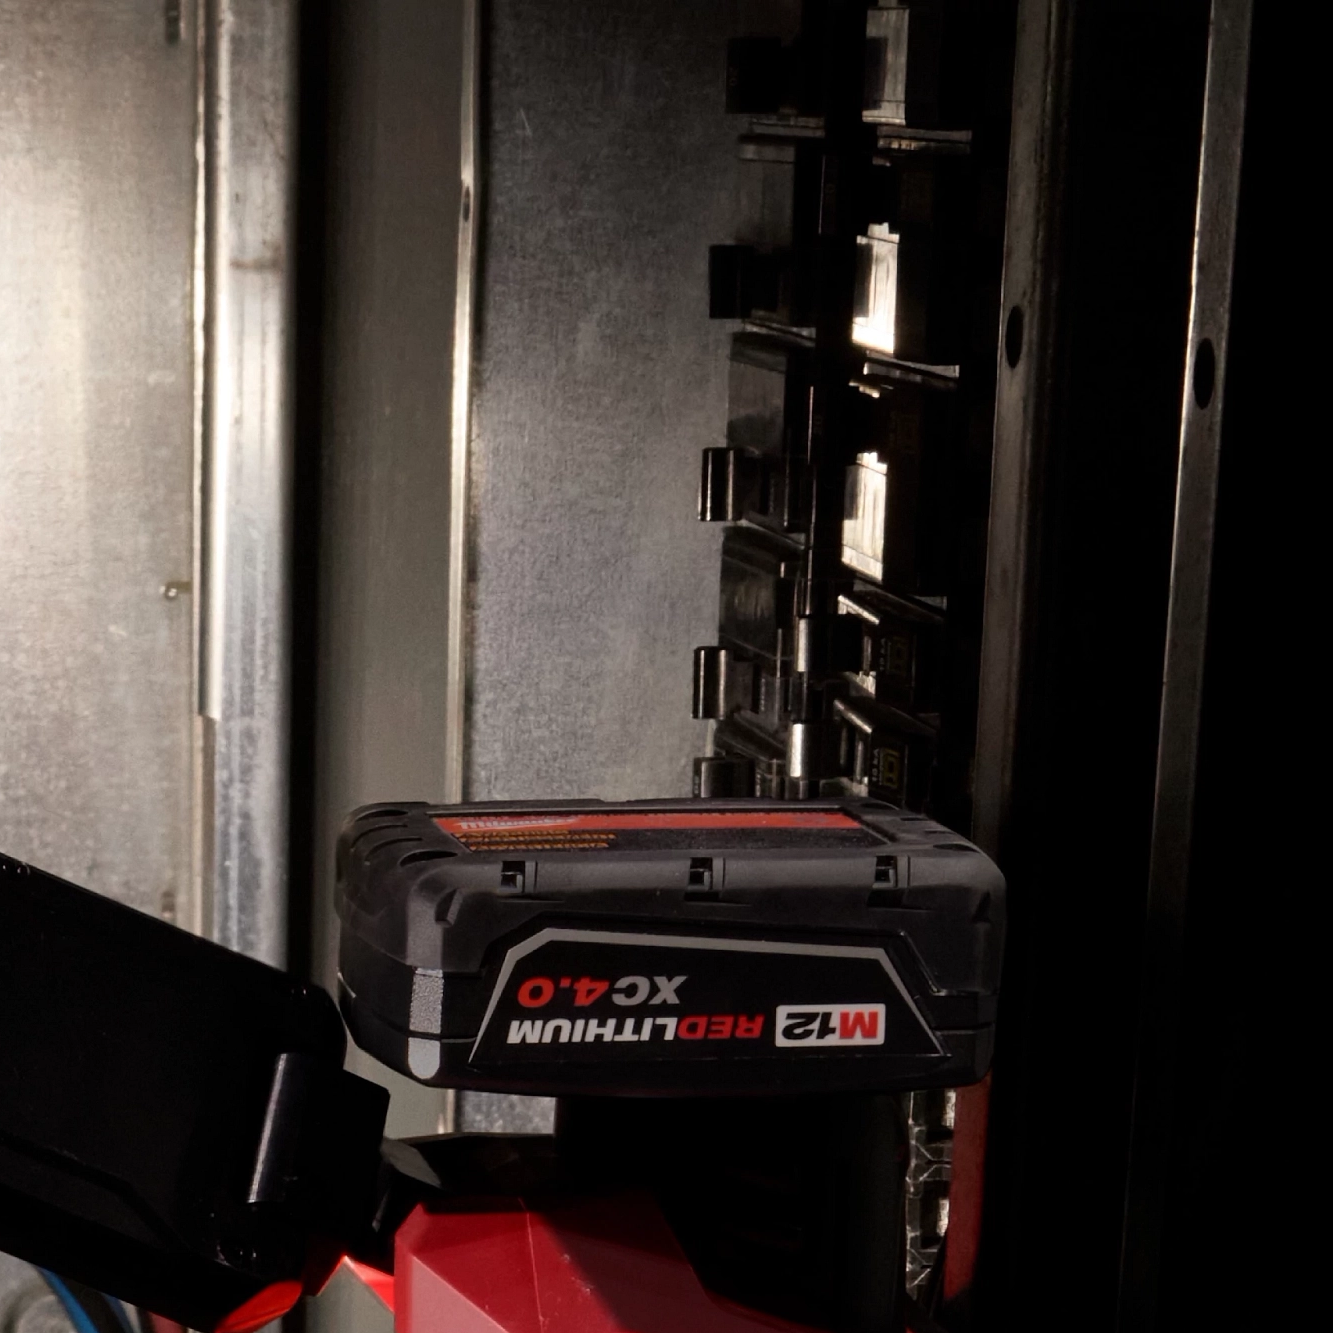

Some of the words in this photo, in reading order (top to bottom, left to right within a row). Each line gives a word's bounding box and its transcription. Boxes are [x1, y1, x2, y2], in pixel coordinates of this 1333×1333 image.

[517, 974, 688, 1008] XC4.0
[506, 1013, 765, 1044] REDLITHIUM
[780, 1010, 880, 1040] M12
